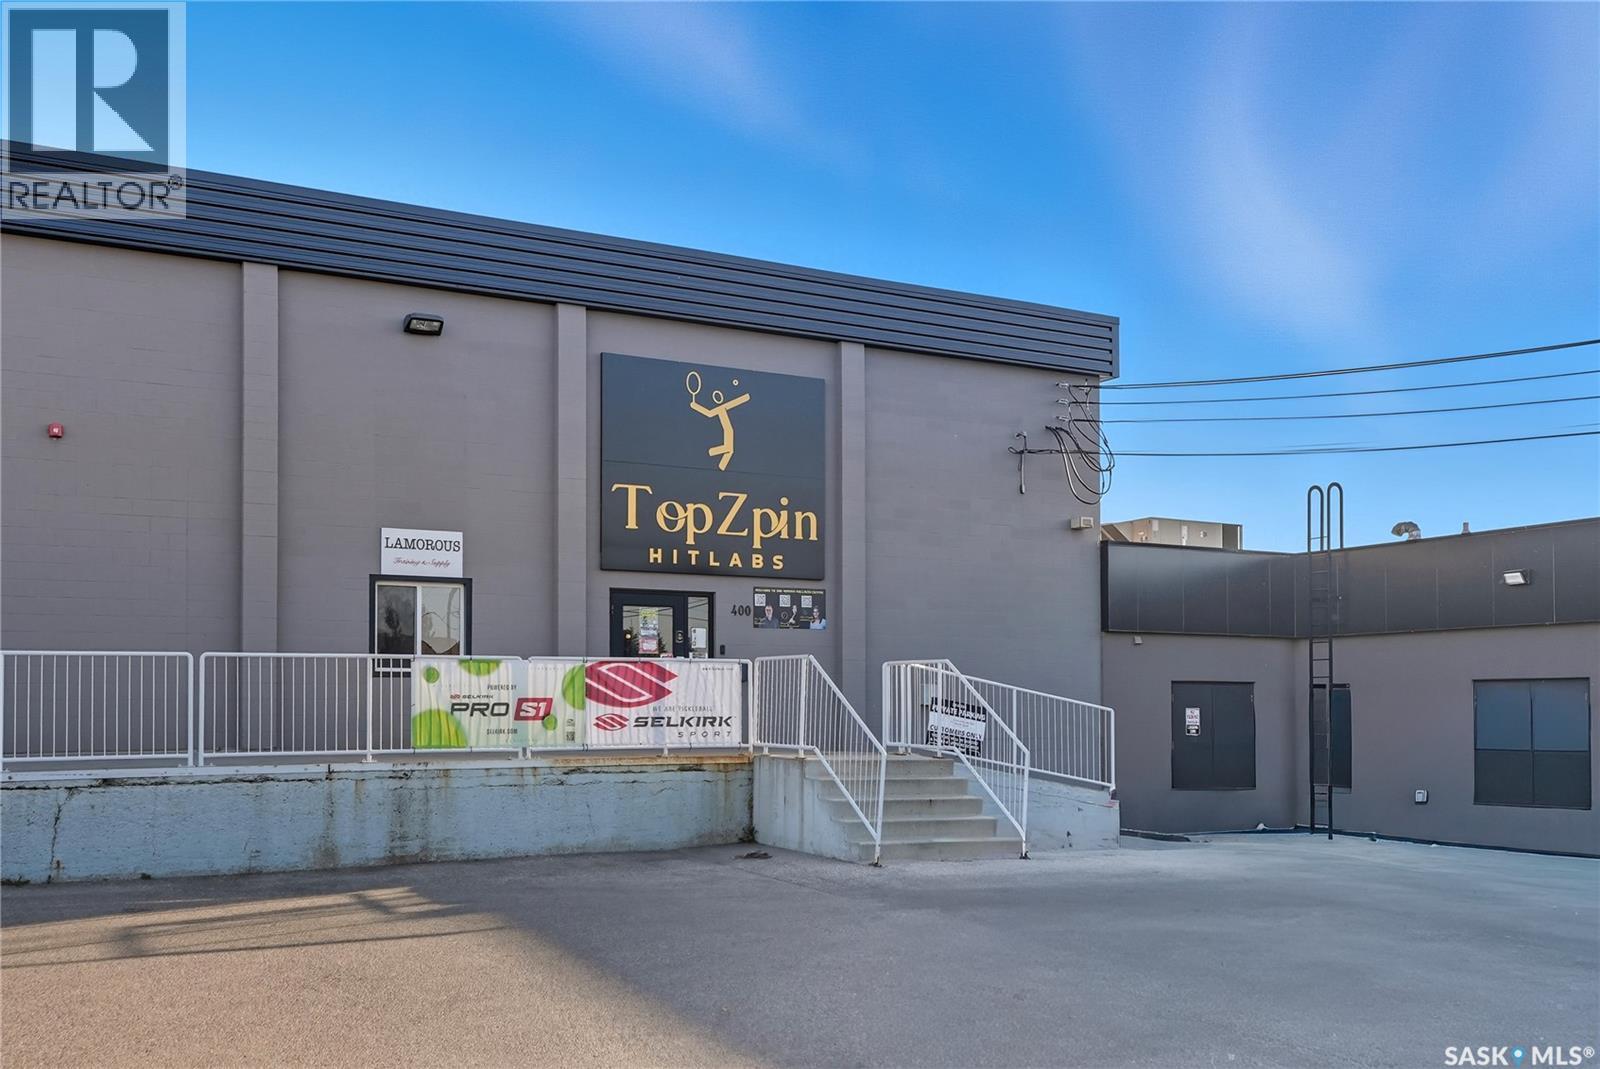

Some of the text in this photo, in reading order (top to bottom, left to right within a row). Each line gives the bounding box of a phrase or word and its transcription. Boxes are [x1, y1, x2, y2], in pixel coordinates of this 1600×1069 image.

[611, 483, 818, 549] TopZpin
[384, 536, 461, 553] LAMOROUS
[429, 558, 452, 568] Supply
[649, 548, 784, 570] HITLABS
[730, 604, 752, 616] 400
[450, 701, 547, 717] PRO S1
[633, 716, 733, 728] SELKIRK
[677, 731, 732, 739] SPORT
[929, 724, 965, 736] CUTOMERS
